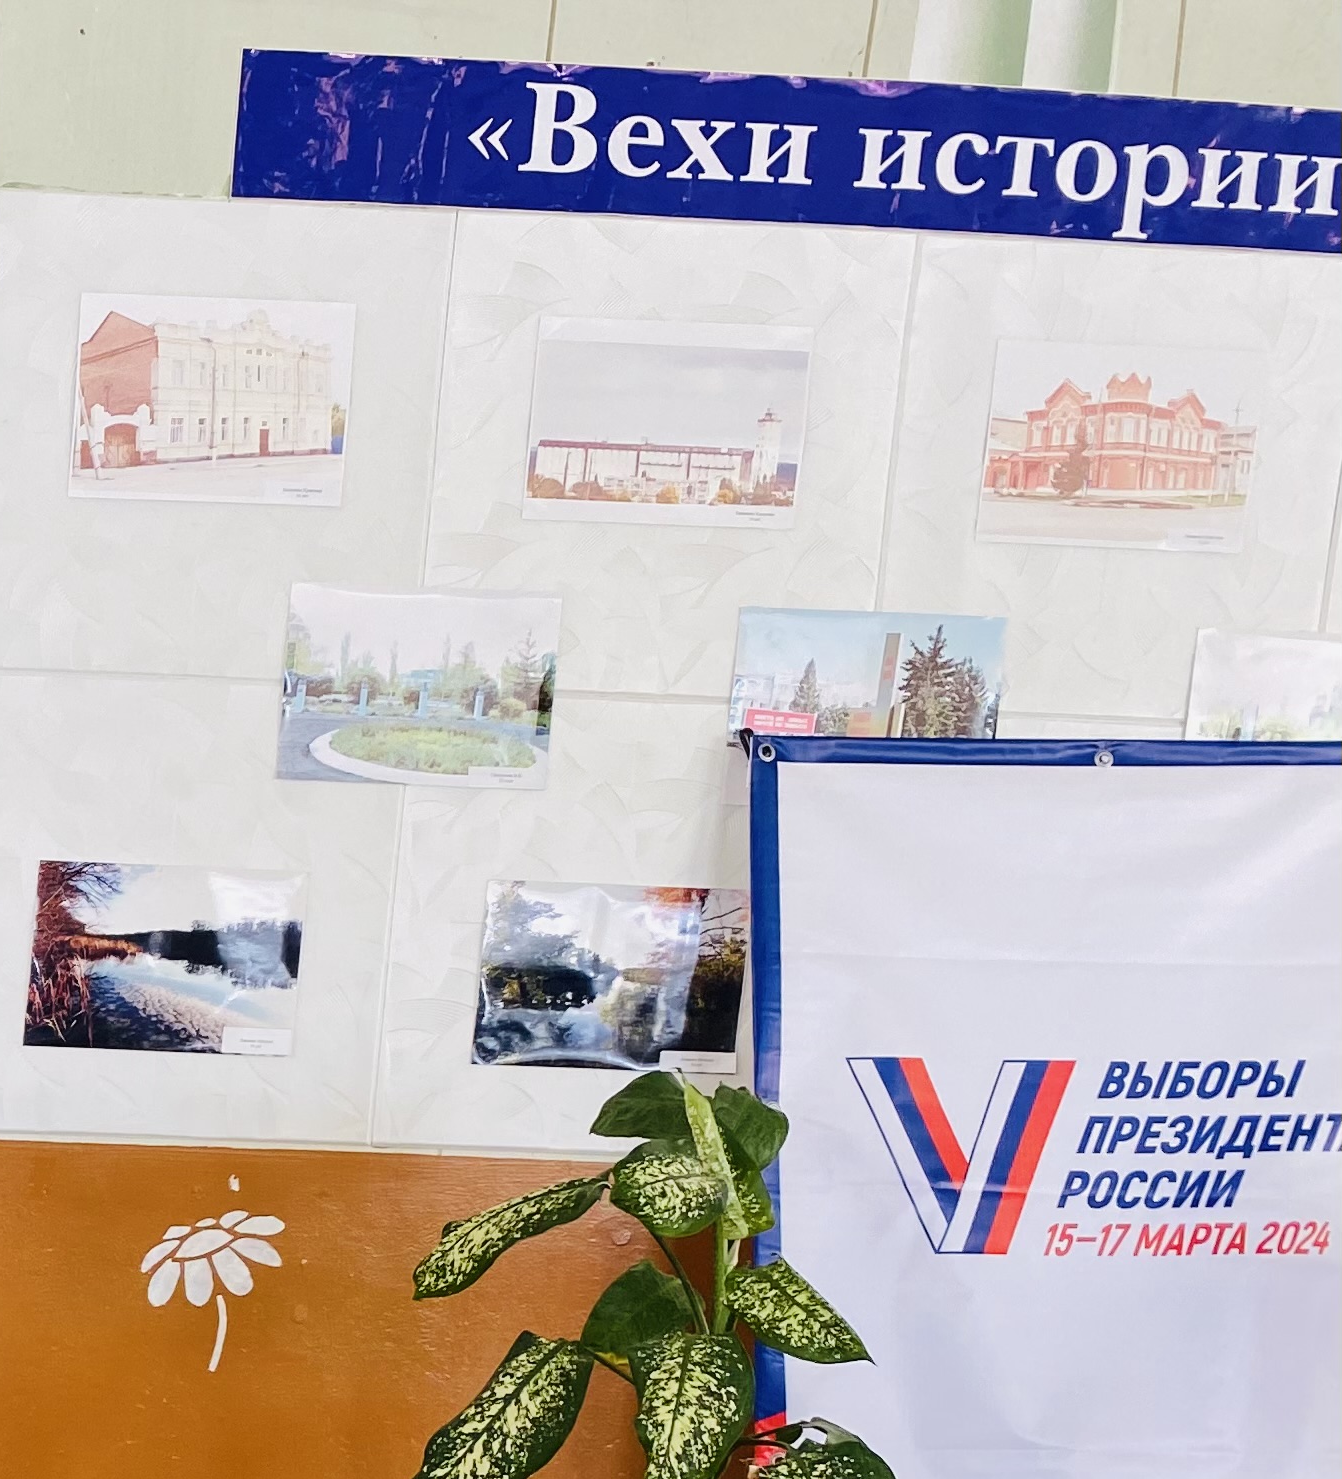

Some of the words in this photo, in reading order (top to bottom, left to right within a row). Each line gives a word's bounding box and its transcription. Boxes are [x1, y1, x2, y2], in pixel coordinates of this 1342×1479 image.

[467, 80, 818, 187] «Вехи
[852, 125, 1342, 241] истории
[1097, 1059, 1306, 1100] ВЫБОРЫ
[1076, 1113, 1342, 1160] ПРЕЗИДЕНТ
[1057, 1168, 1245, 1209] РОССИИ
[1134, 1222, 1247, 1257] МАРТА
[1255, 1220, 1330, 1256] 2024
